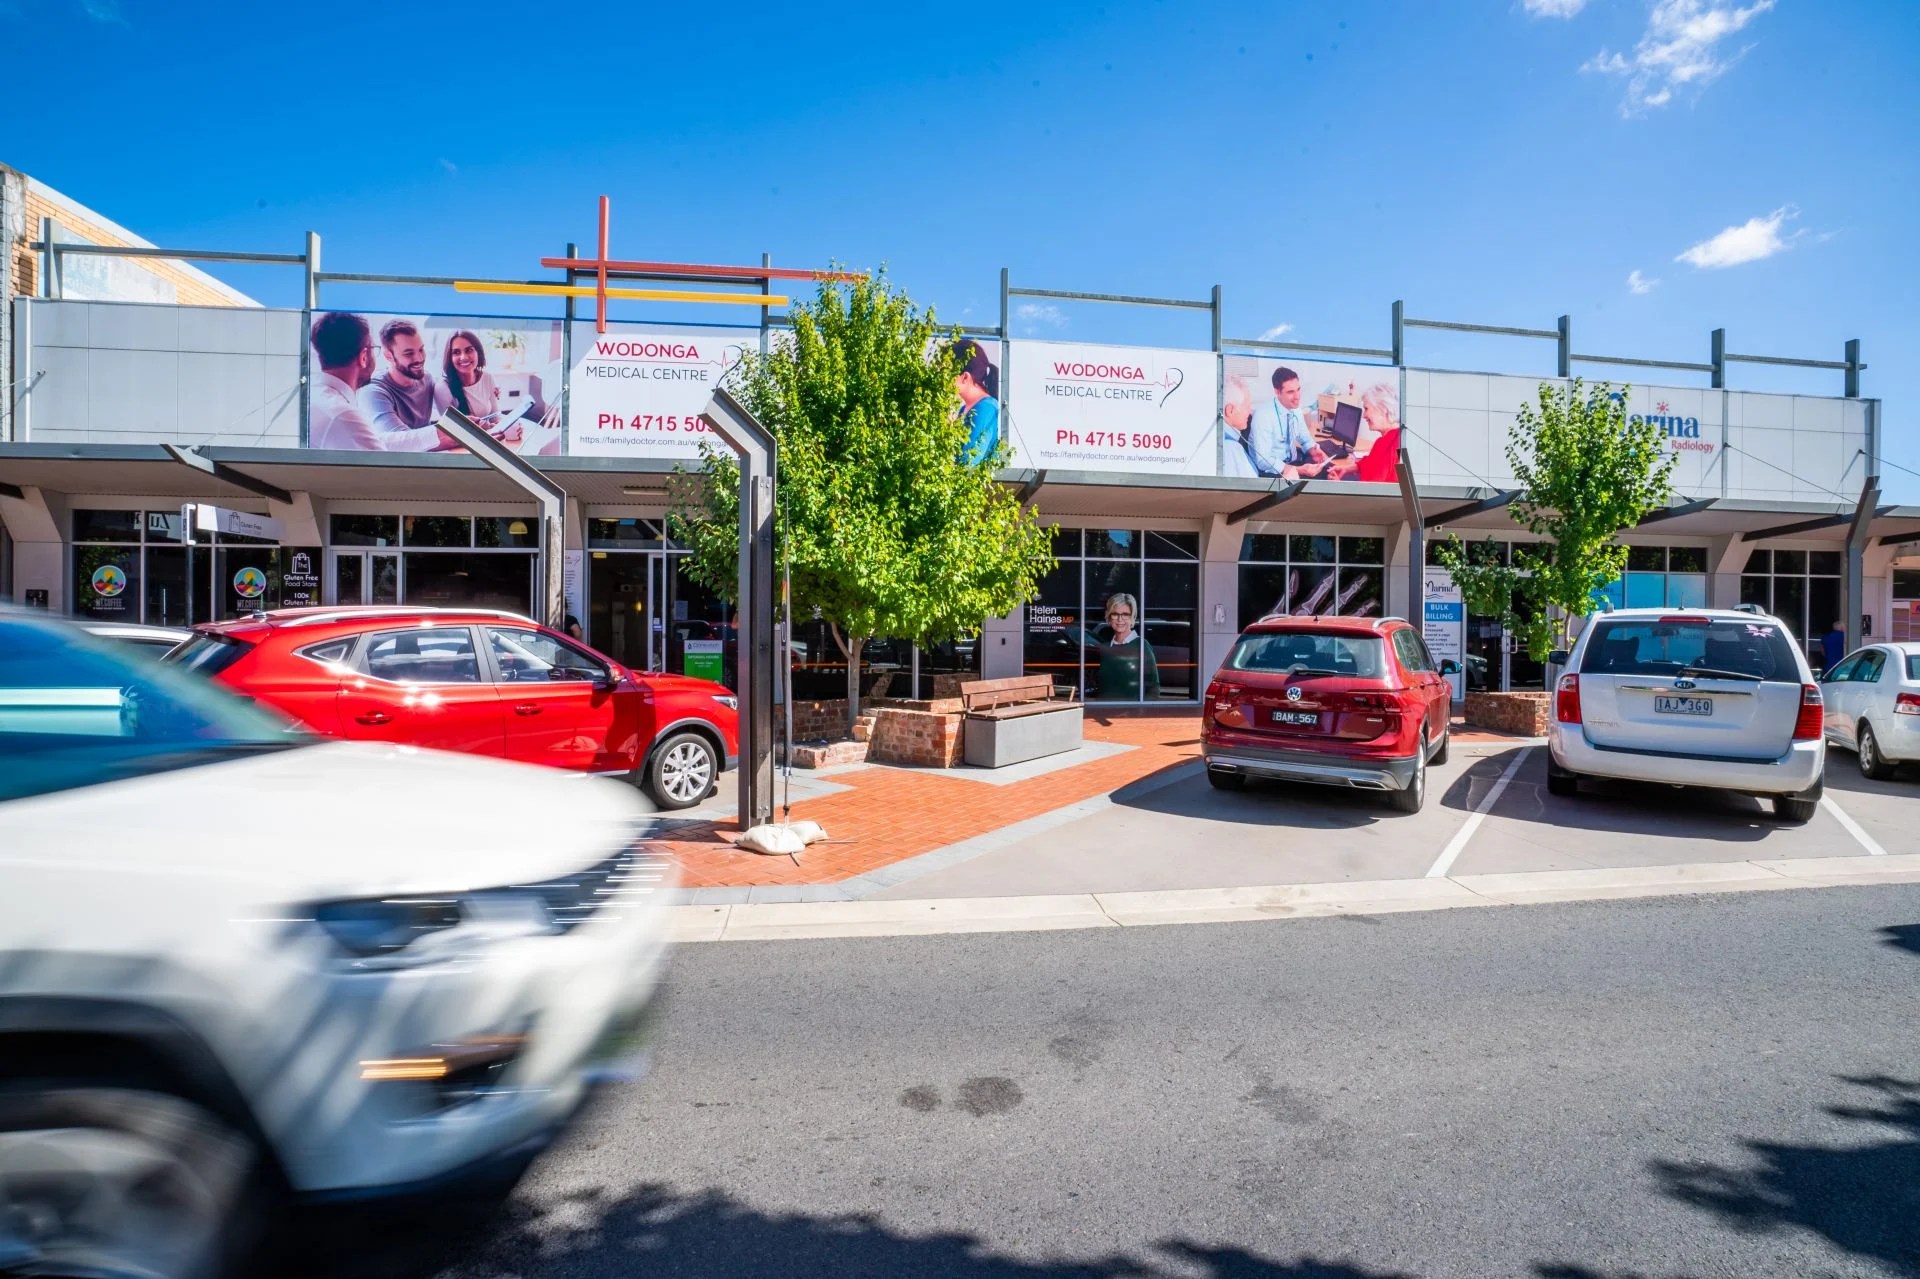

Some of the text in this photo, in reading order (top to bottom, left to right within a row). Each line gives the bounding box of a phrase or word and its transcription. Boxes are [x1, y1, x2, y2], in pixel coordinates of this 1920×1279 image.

[596, 341, 699, 359] WODONGA
[586, 366, 708, 381] MEDICAL CENTRE
[1054, 362, 1145, 380] WODONGA
[1045, 385, 1153, 401] MEDICAL CENTRE
[598, 413, 714, 432] Ph 4715 50
[1056, 430, 1172, 449] Ph 4715 5090
[1671, 440, 1715, 454] Radiology
[1030, 605, 1057, 614] Helen
[1430, 603, 1449, 611] BULK
[1030, 614, 1062, 623] Haines
